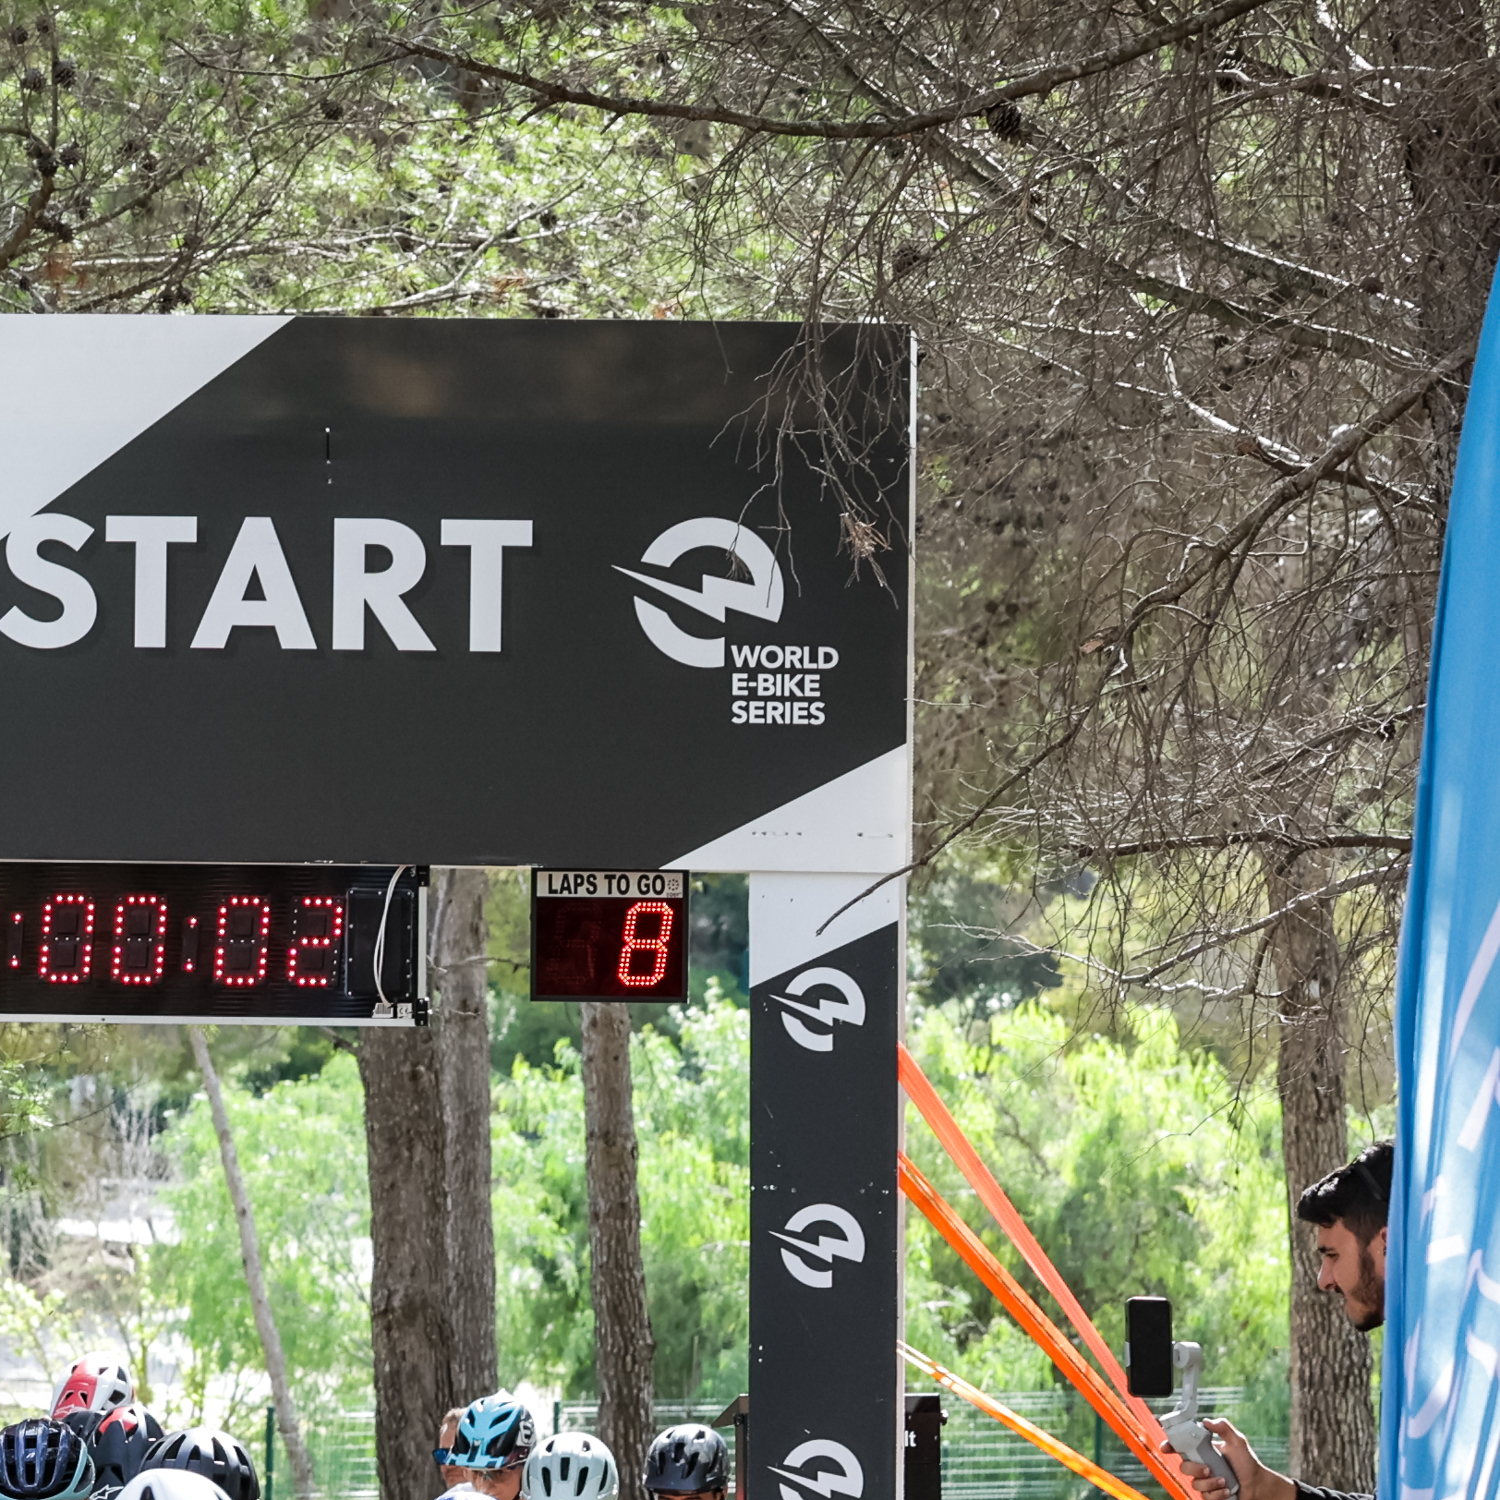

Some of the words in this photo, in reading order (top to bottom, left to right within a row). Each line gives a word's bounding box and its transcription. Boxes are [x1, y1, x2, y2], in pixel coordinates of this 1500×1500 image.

[732, 646, 839, 669] WORLD
[732, 674, 821, 697] E-BIKE
[732, 702, 825, 726] SERIES
[548, 873, 598, 895] LAPS
[604, 874, 630, 896] TO
[637, 874, 666, 896] GO
[617, 901, 674, 986] 8
